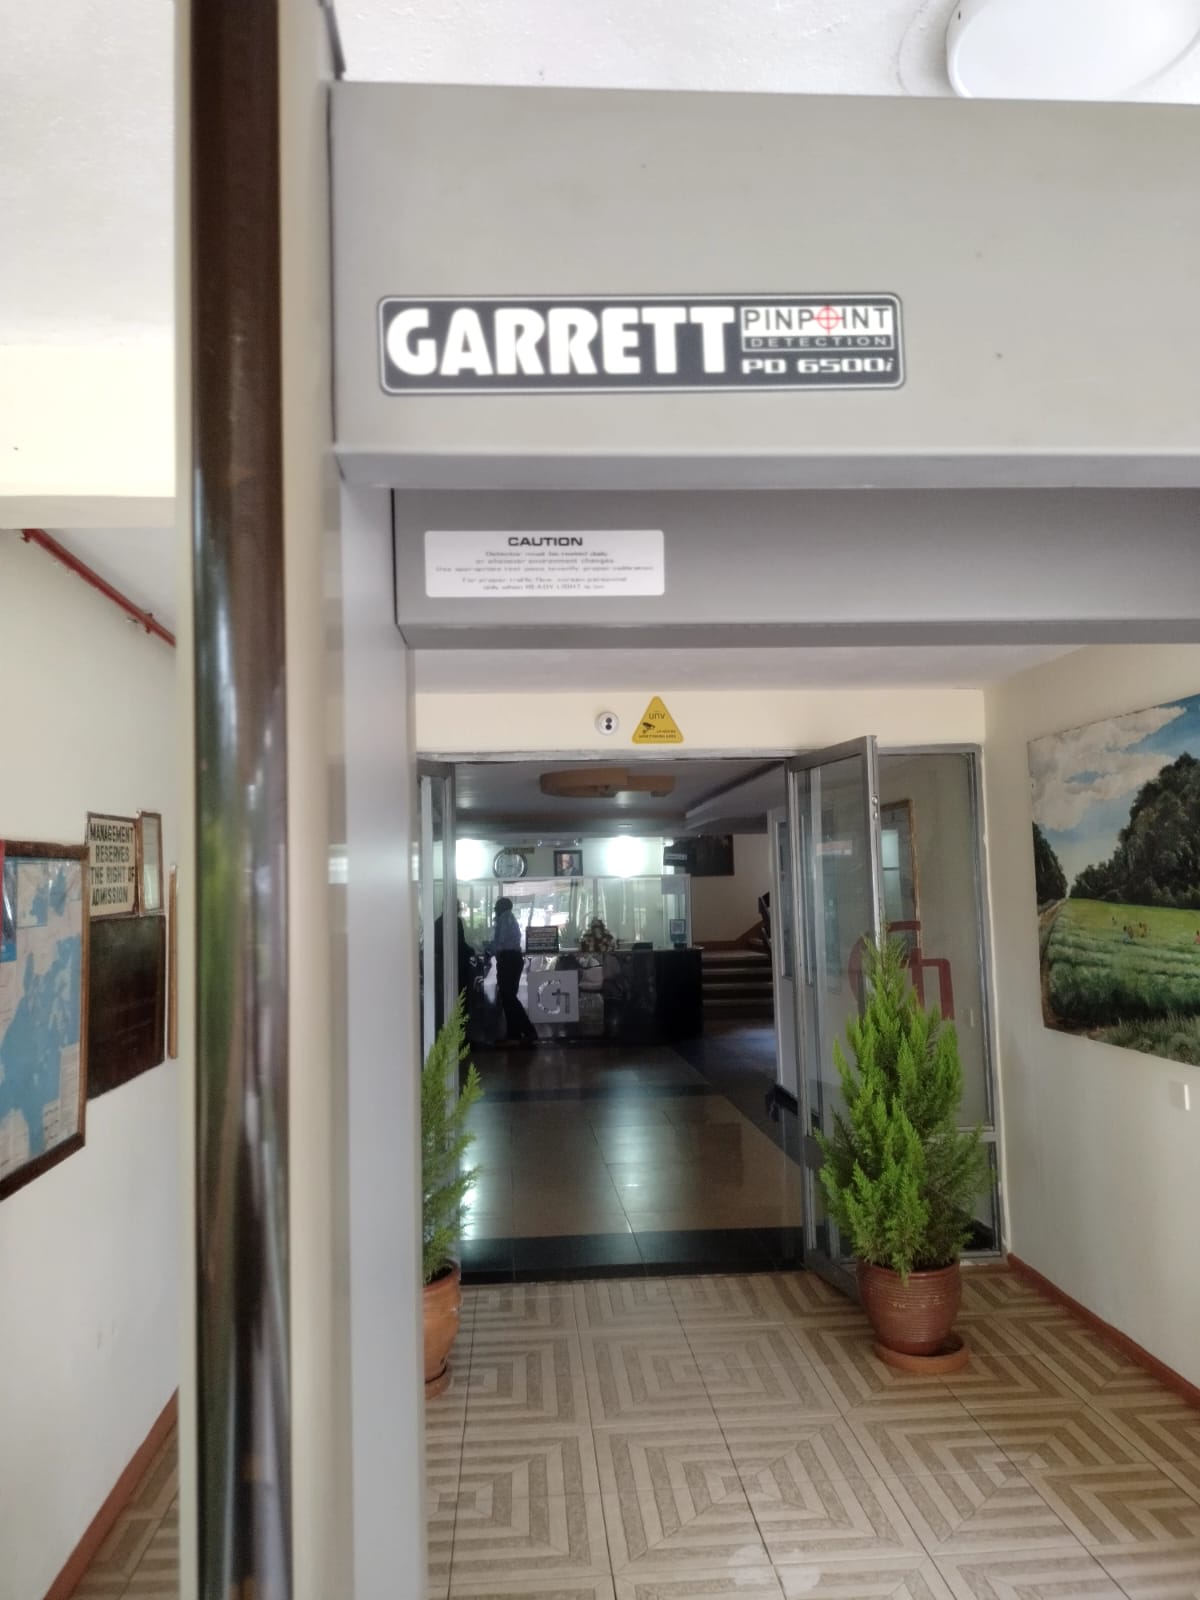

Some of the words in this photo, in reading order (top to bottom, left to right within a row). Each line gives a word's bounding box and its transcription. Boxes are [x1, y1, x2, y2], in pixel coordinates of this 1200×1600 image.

[744, 305, 890, 332] PINPOINT
[386, 306, 735, 376] GARRETT
[751, 336, 887, 348] DETECTION
[742, 358, 786, 374] PD
[797, 357, 894, 374] 6500i
[507, 536, 583, 547] CAUTION
[89, 823, 134, 844] MANAGEMENT
[95, 844, 130, 864] RESERVES
[90, 866, 103, 885] THE
[106, 866, 126, 883] RIGHT
[128, 866, 135, 882] OF
[91, 886, 128, 906] ADMISSION
